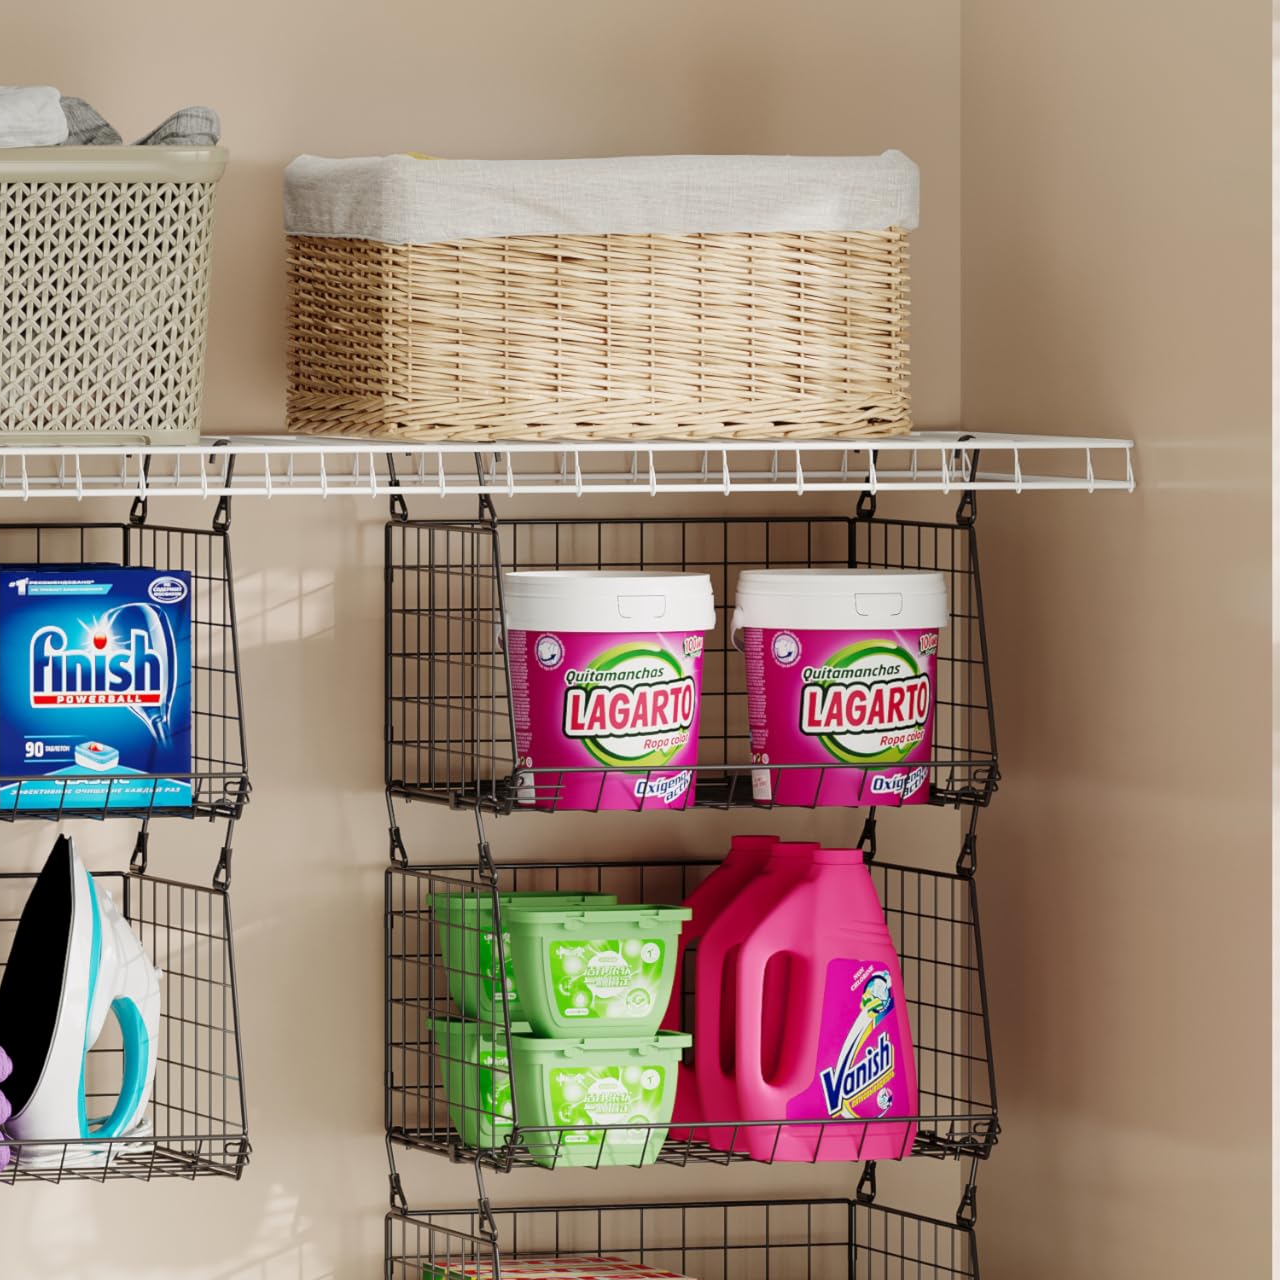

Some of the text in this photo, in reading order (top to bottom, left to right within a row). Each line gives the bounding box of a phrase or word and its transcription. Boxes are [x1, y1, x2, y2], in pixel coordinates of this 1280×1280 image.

[30, 626, 162, 693] finish
[566, 667, 664, 685] Quitamanchas
[803, 664, 901, 681] Quitamanchas
[56, 693, 143, 704] POWERBALL
[807, 681, 928, 727] LAGARTO
[570, 684, 692, 731] LAGARTO
[25, 741, 44, 758] 90
[643, 738, 669, 750] Ropa
[880, 735, 905, 747] Ropa
[821, 1032, 891, 1112] Vanish
